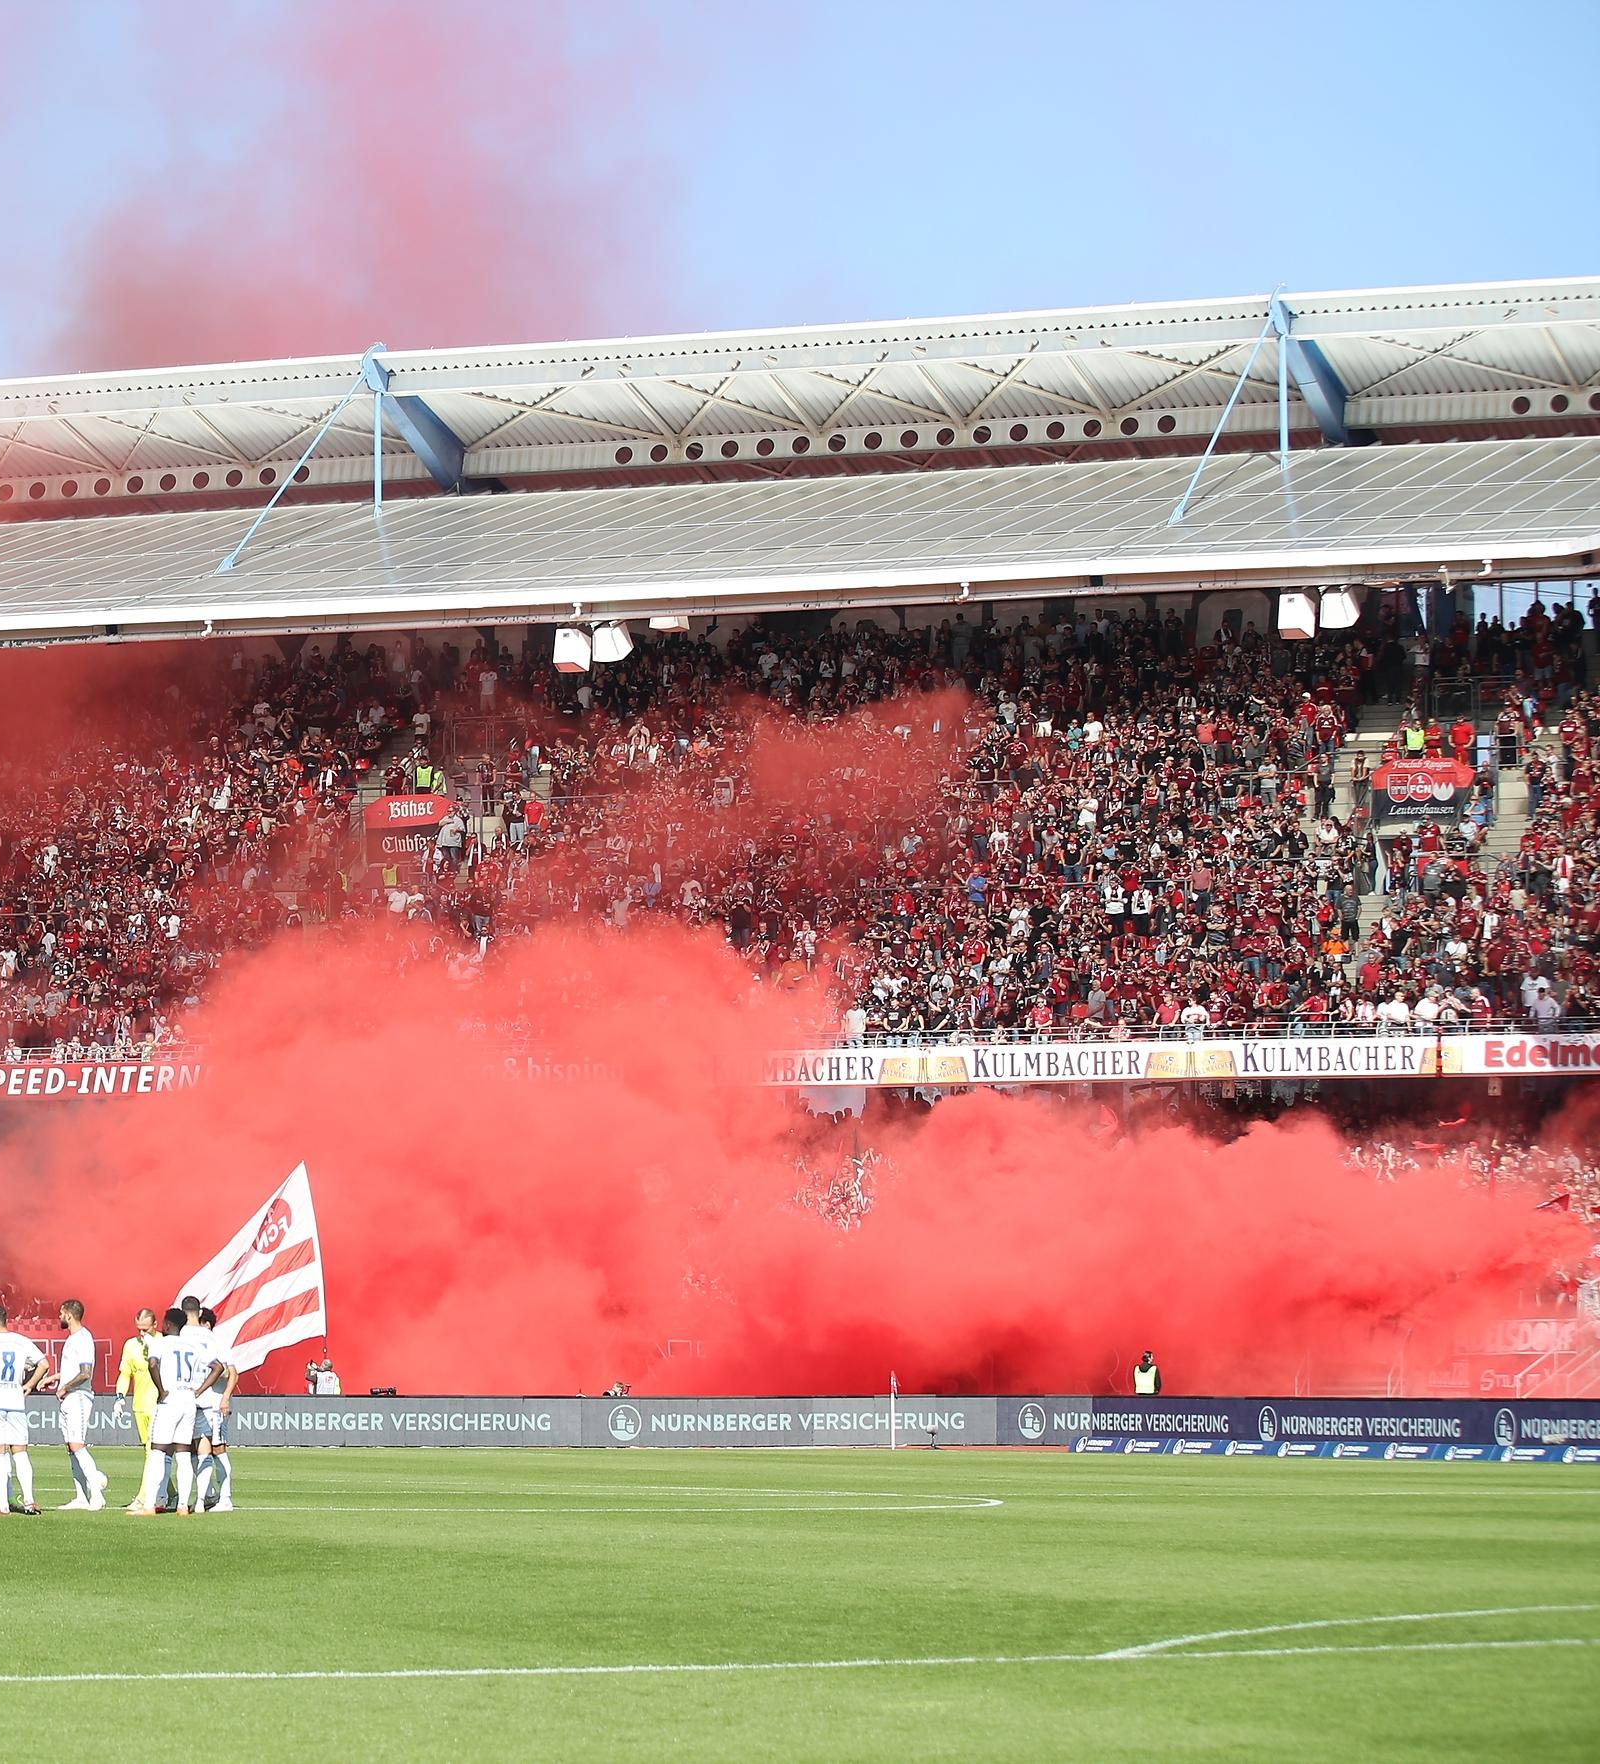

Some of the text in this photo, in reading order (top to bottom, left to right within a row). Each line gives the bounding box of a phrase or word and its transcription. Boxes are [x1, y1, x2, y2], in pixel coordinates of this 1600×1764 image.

[1410, 784, 1432, 794] FCN
[388, 801, 434, 822] Böhse
[1388, 803, 1456, 816] Leutershausen
[973, 1048, 1141, 1078] KULMBACHER
[1242, 1042, 1415, 1073] KULMBACHER
[1, 1351, 16, 1382] 8
[173, 1350, 194, 1382] 15
[237, 1411, 551, 1432] NÜRNBERGER VERSICHERUNG
[650, 1411, 966, 1432] NÜRNBERGER VERSICHERUNG
[1053, 1411, 1229, 1434] NÜRNBERGER VERSICHERUNG
[1281, 1415, 1461, 1438] NÜRNBERGER VERSICHERUNG
